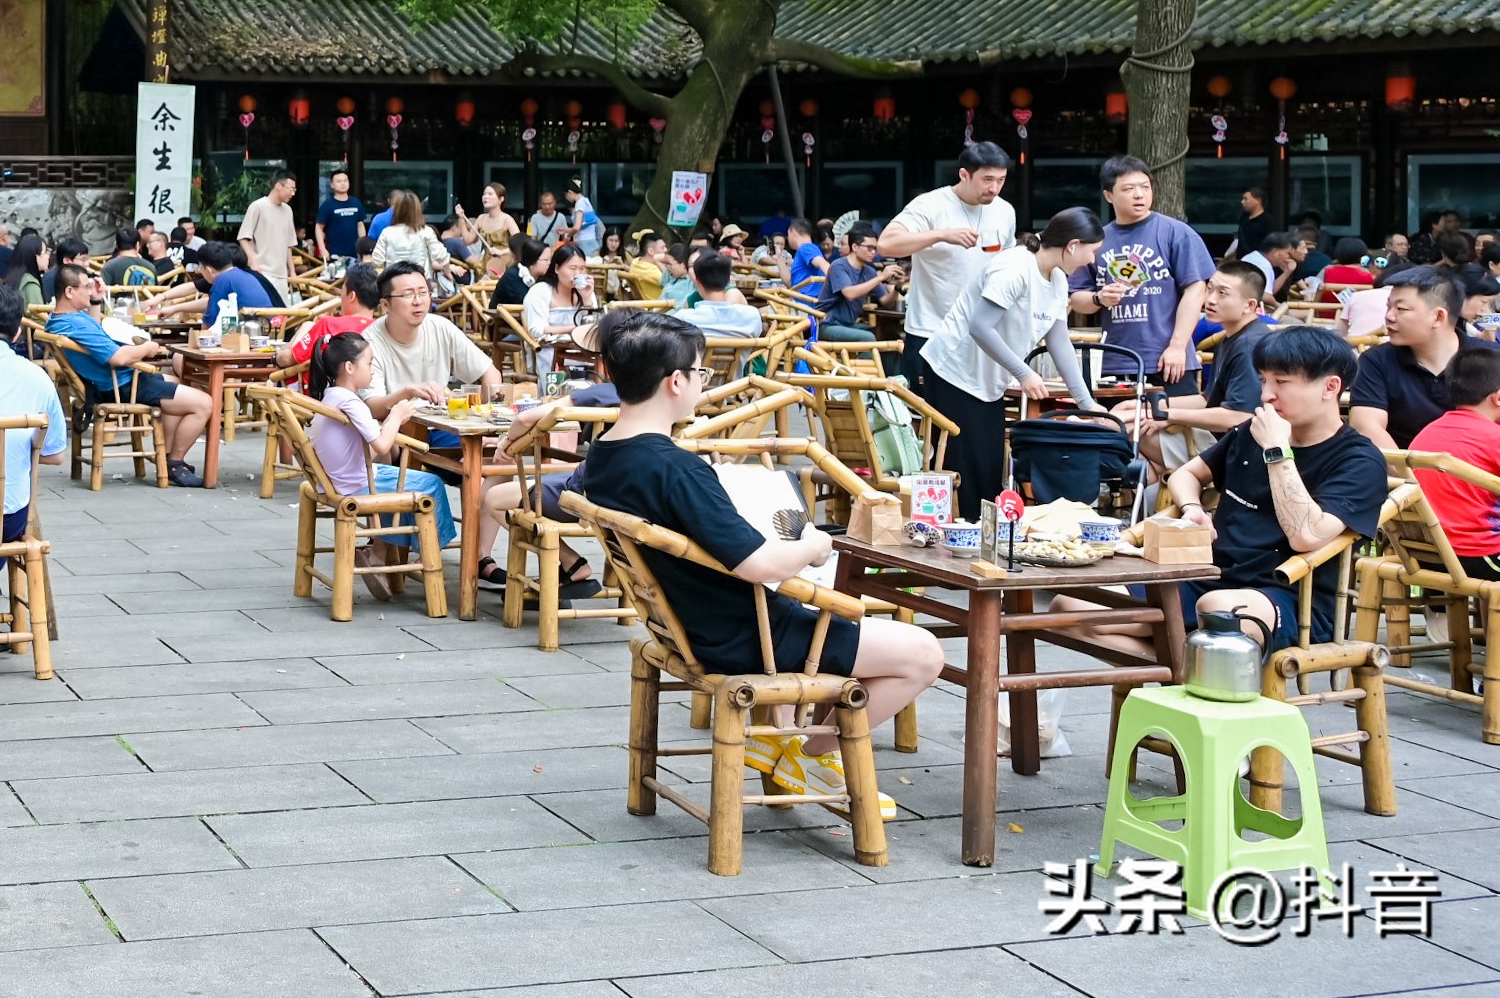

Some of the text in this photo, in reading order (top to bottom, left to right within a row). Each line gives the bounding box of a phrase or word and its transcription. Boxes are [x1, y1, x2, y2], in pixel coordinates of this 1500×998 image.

[148, 102, 181, 214] 余生很
[1111, 303, 1149, 319] MIAMI
